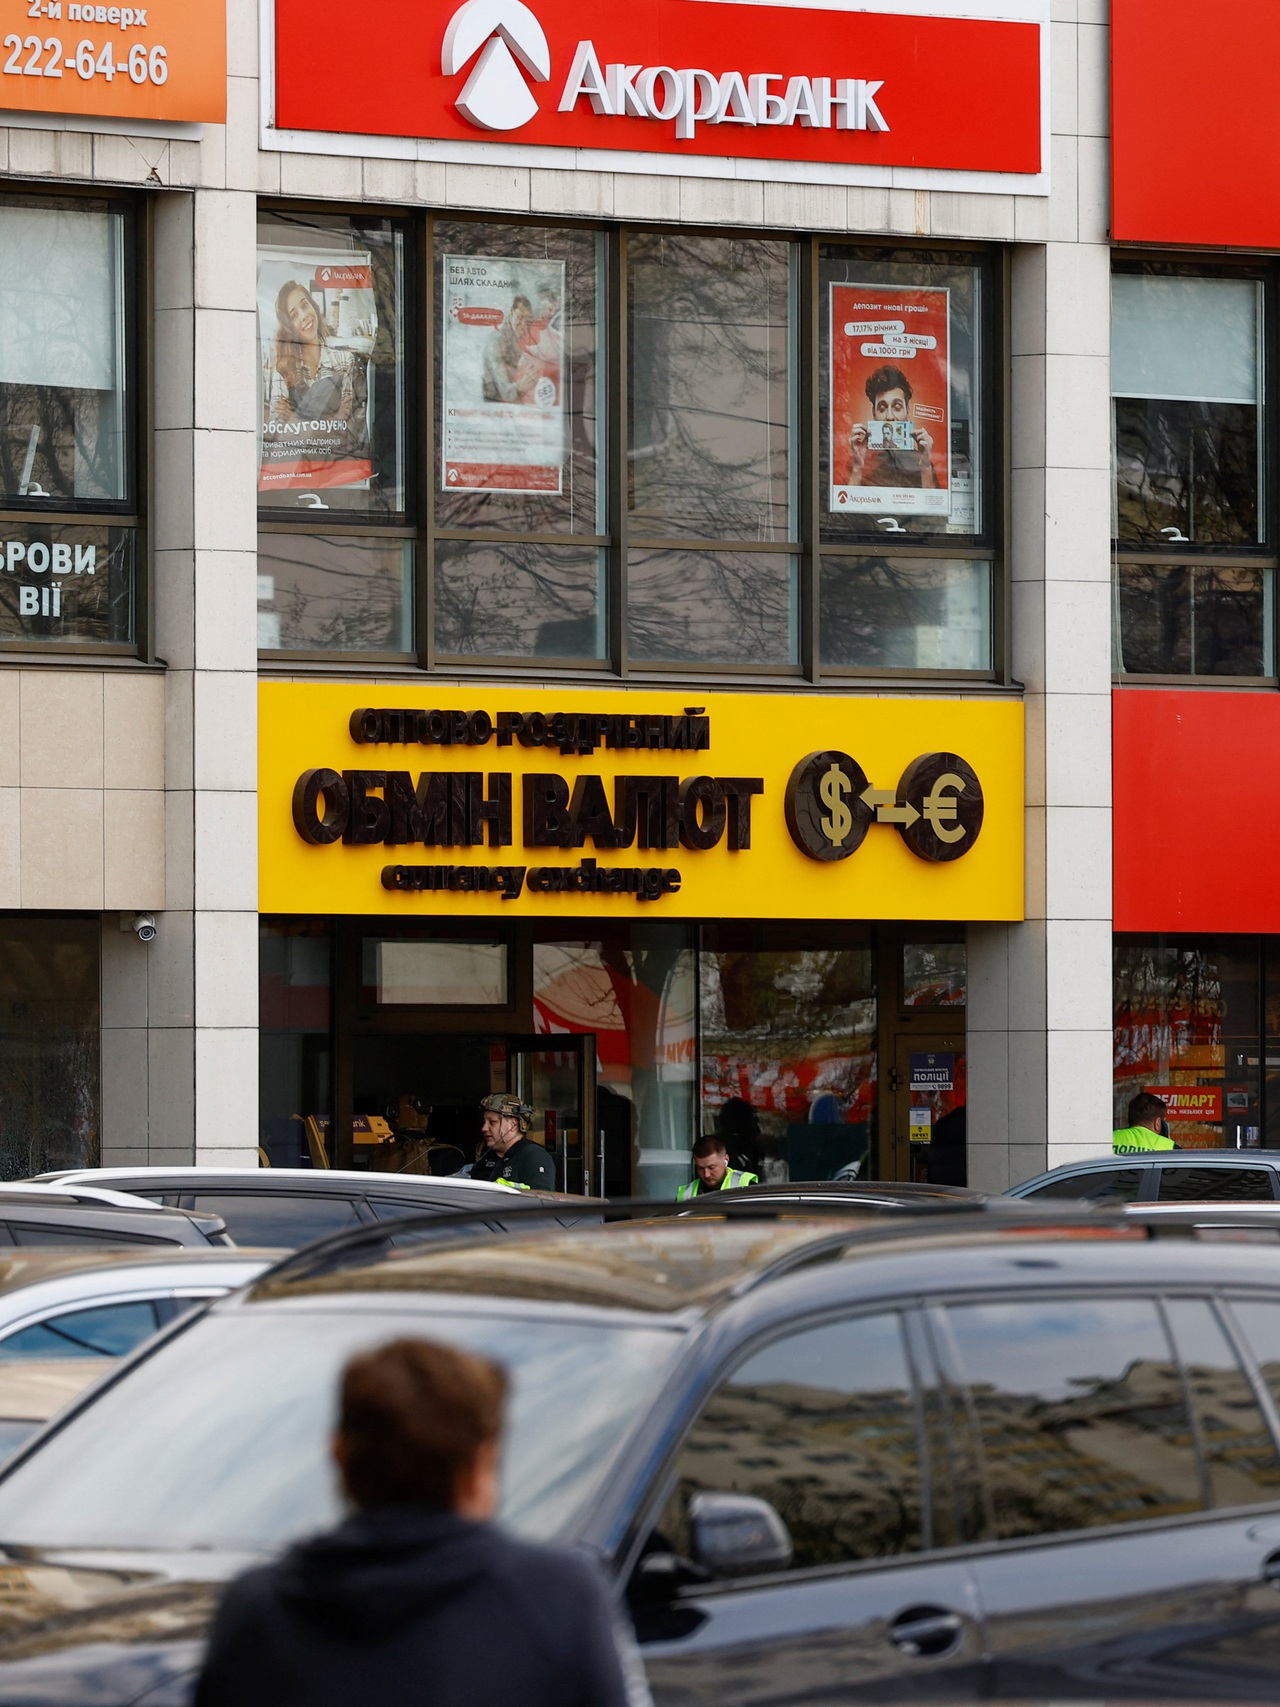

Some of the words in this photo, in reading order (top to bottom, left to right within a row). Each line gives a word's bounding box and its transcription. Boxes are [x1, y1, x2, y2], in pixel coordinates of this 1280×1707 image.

[68, 3, 148, 30] поверх
[3, 34, 168, 86] 222-64-66
[449, 266, 465, 274] БЕЗ
[467, 267, 487, 276] АВТО
[449, 277, 475, 286] ШЛЯХ
[853, 303, 882, 311] депозит
[852, 324, 873, 334] 17,17%
[874, 324, 898, 333] річних
[867, 346, 878, 355] від
[909, 337, 929, 347] місяці
[270, 447, 318, 458] юридичних
[318, 446, 332, 454] осіб
[0, 541, 96, 575] РОВИ
[19, 581, 63, 617] ВІЇ
[349, 707, 710, 755] ОПТОВО-РОЗДРІБНИЙ
[292, 767, 512, 846] ОБМІН
[522, 772, 765, 851] ВАЛЮТ
[381, 865, 527, 900] currency
[527, 858, 682, 901] exchange
